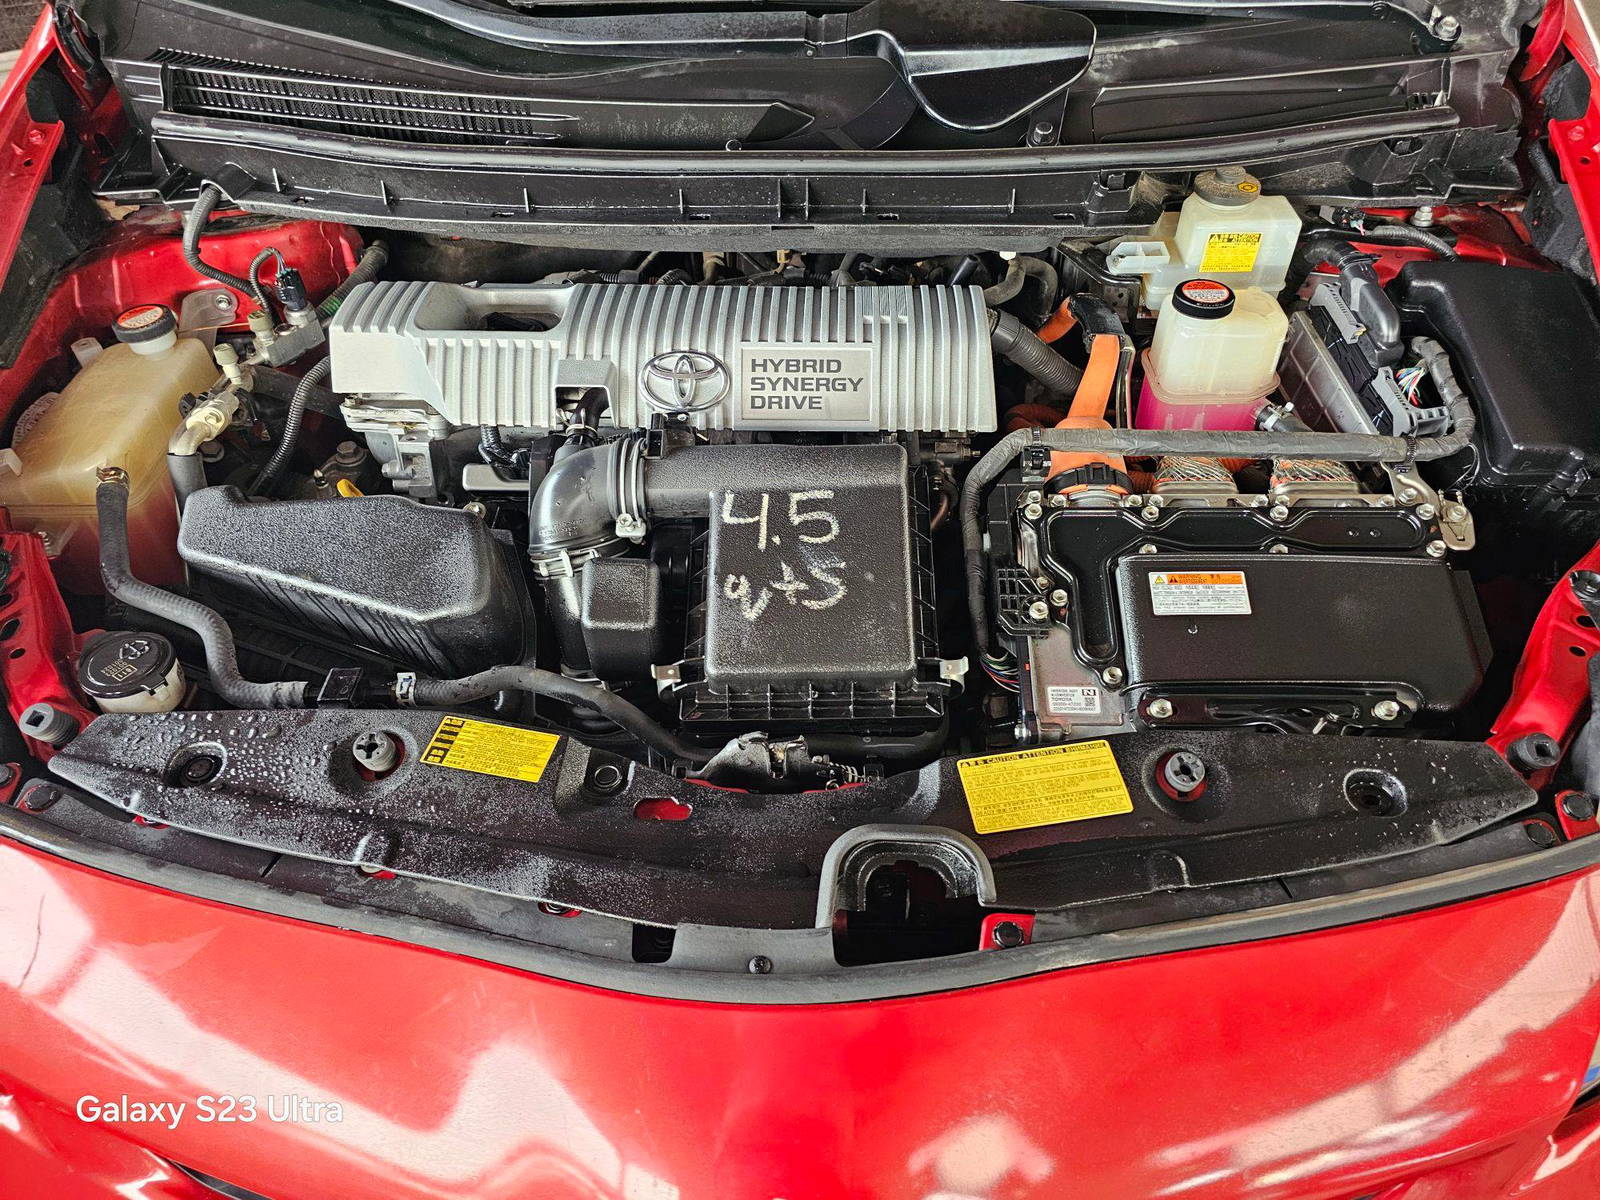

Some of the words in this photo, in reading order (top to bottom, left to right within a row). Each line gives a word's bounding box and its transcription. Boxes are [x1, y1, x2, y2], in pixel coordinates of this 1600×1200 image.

[751, 358, 842, 373] HYBRID
[750, 376, 864, 392] SYNERGY
[750, 395, 823, 410] DRIVE
[721, 489, 840, 552] 4.5
[986, 754, 1020, 763] CAUTION
[1023, 749, 1063, 758] ATTENTION
